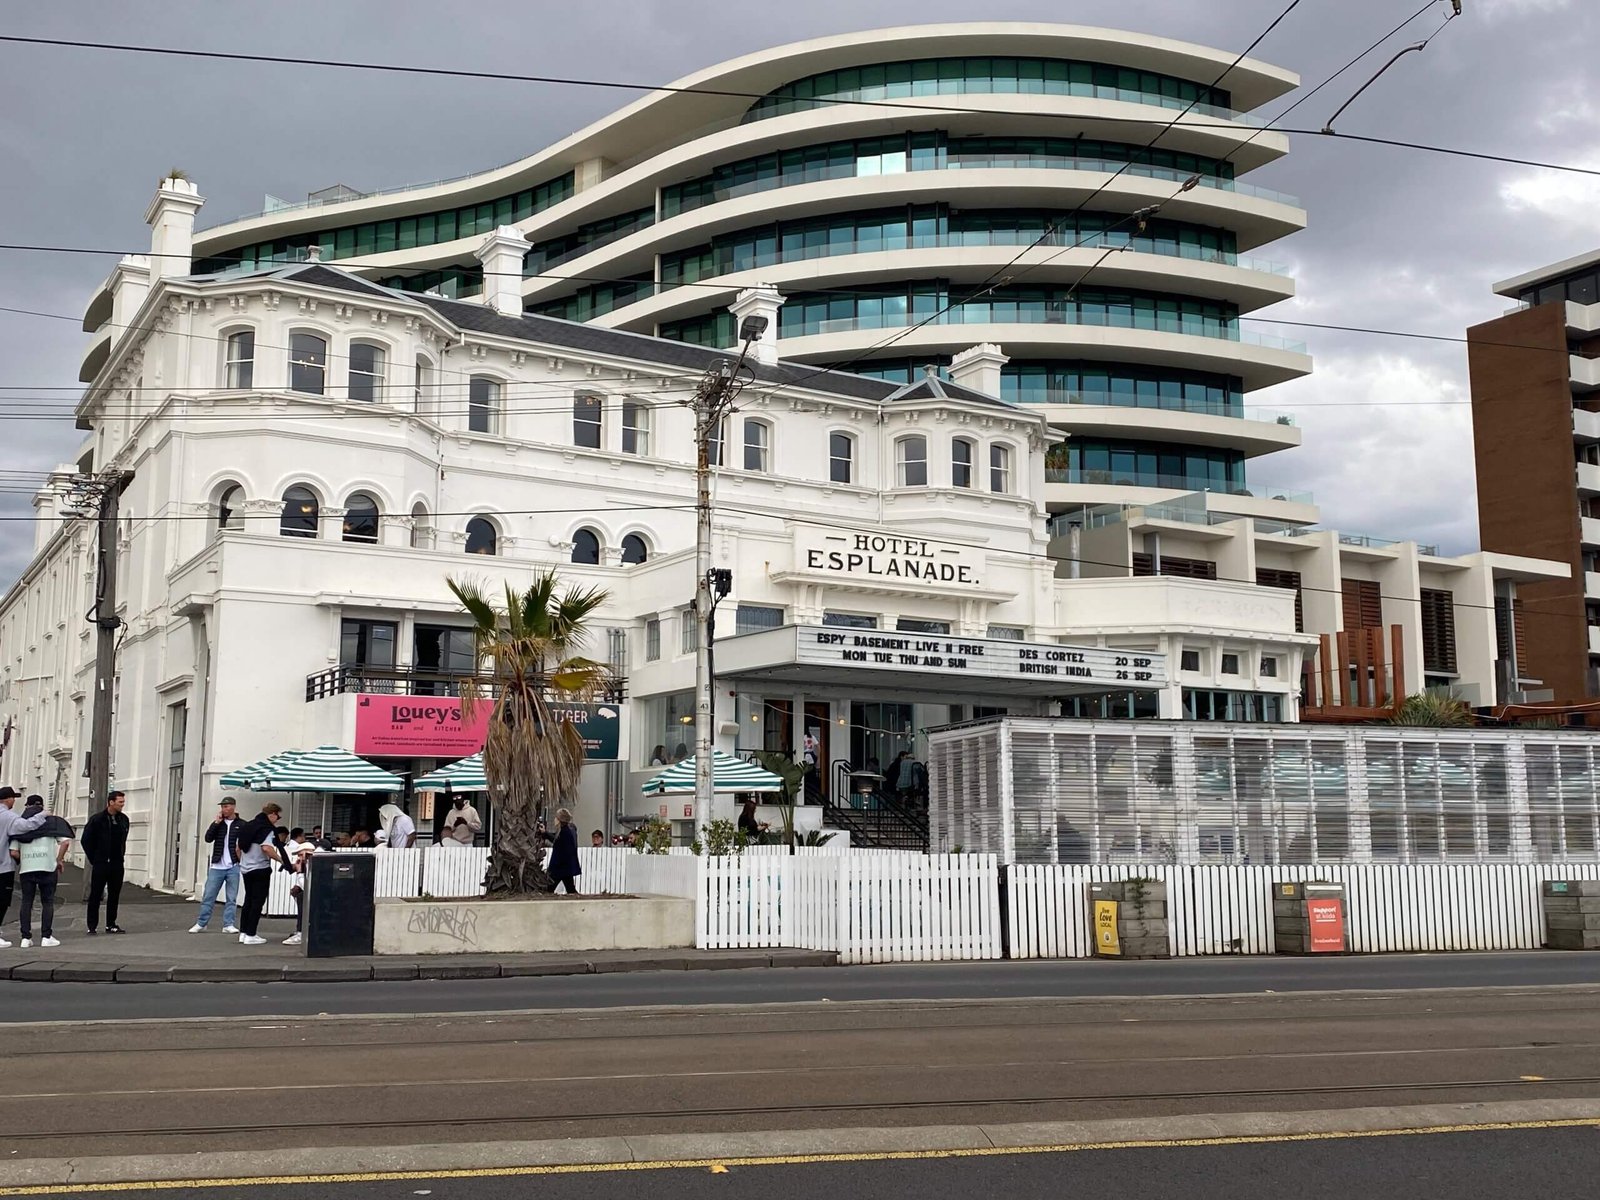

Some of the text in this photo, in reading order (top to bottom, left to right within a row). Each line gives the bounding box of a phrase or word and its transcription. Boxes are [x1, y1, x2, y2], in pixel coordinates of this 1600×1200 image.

[853, 534, 935, 558] HOTEL
[807, 549, 980, 584] ESPLANADE.
[817, 633, 846, 645] ESPY
[854, 636, 910, 649] BASEMENT
[916, 641, 939, 652] LIVE
[958, 644, 984, 656] FREE
[843, 650, 967, 669] MON TUE THU AND SUN
[1019, 649, 1151, 668] DES CORTEZ 20 SEP
[1019, 662, 1152, 681] BRITISH INDIA 26 SEP
[392, 706, 461, 724] Louey's
